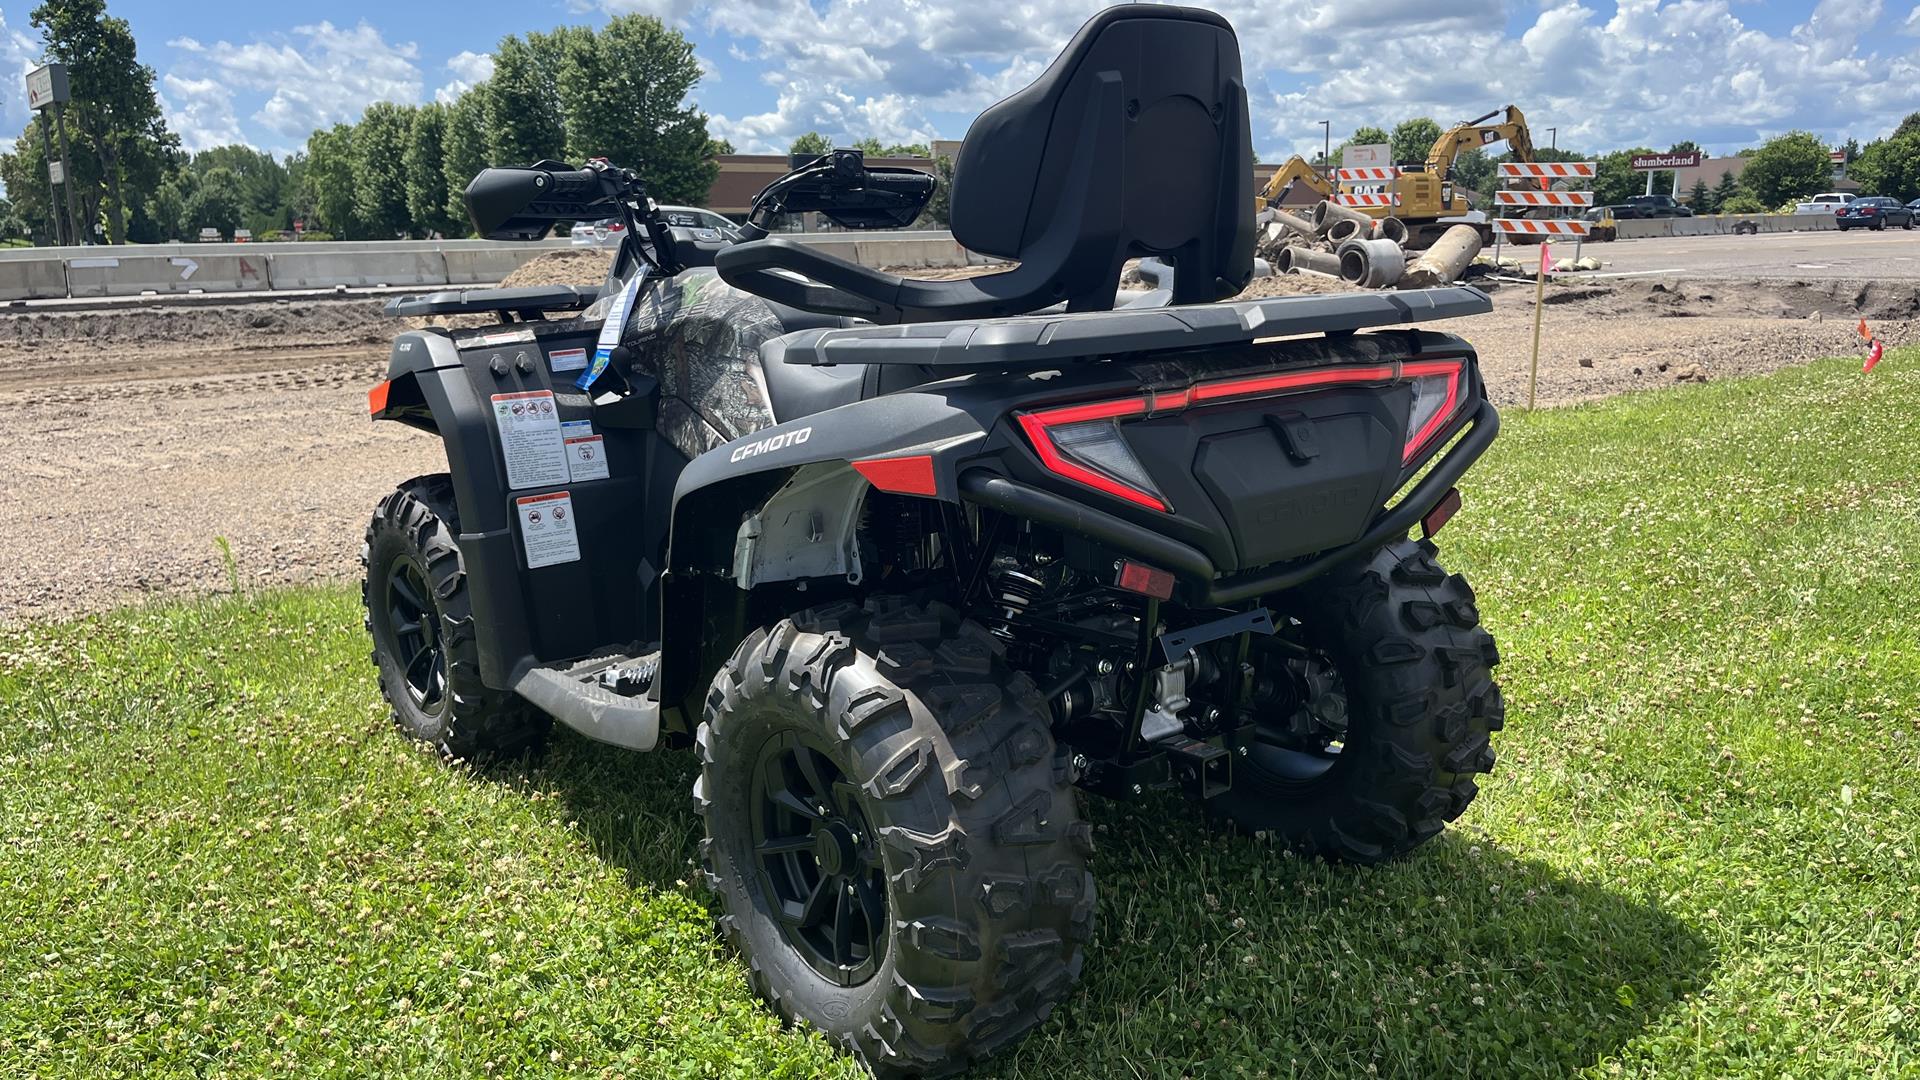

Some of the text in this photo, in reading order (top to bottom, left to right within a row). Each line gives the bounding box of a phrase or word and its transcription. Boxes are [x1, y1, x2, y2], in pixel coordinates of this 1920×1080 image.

[1633, 155, 1694, 168] slumberland
[1354, 185, 1380, 195] CAT
[239, 256, 260, 280] A
[730, 426, 812, 463] CFMOTO
